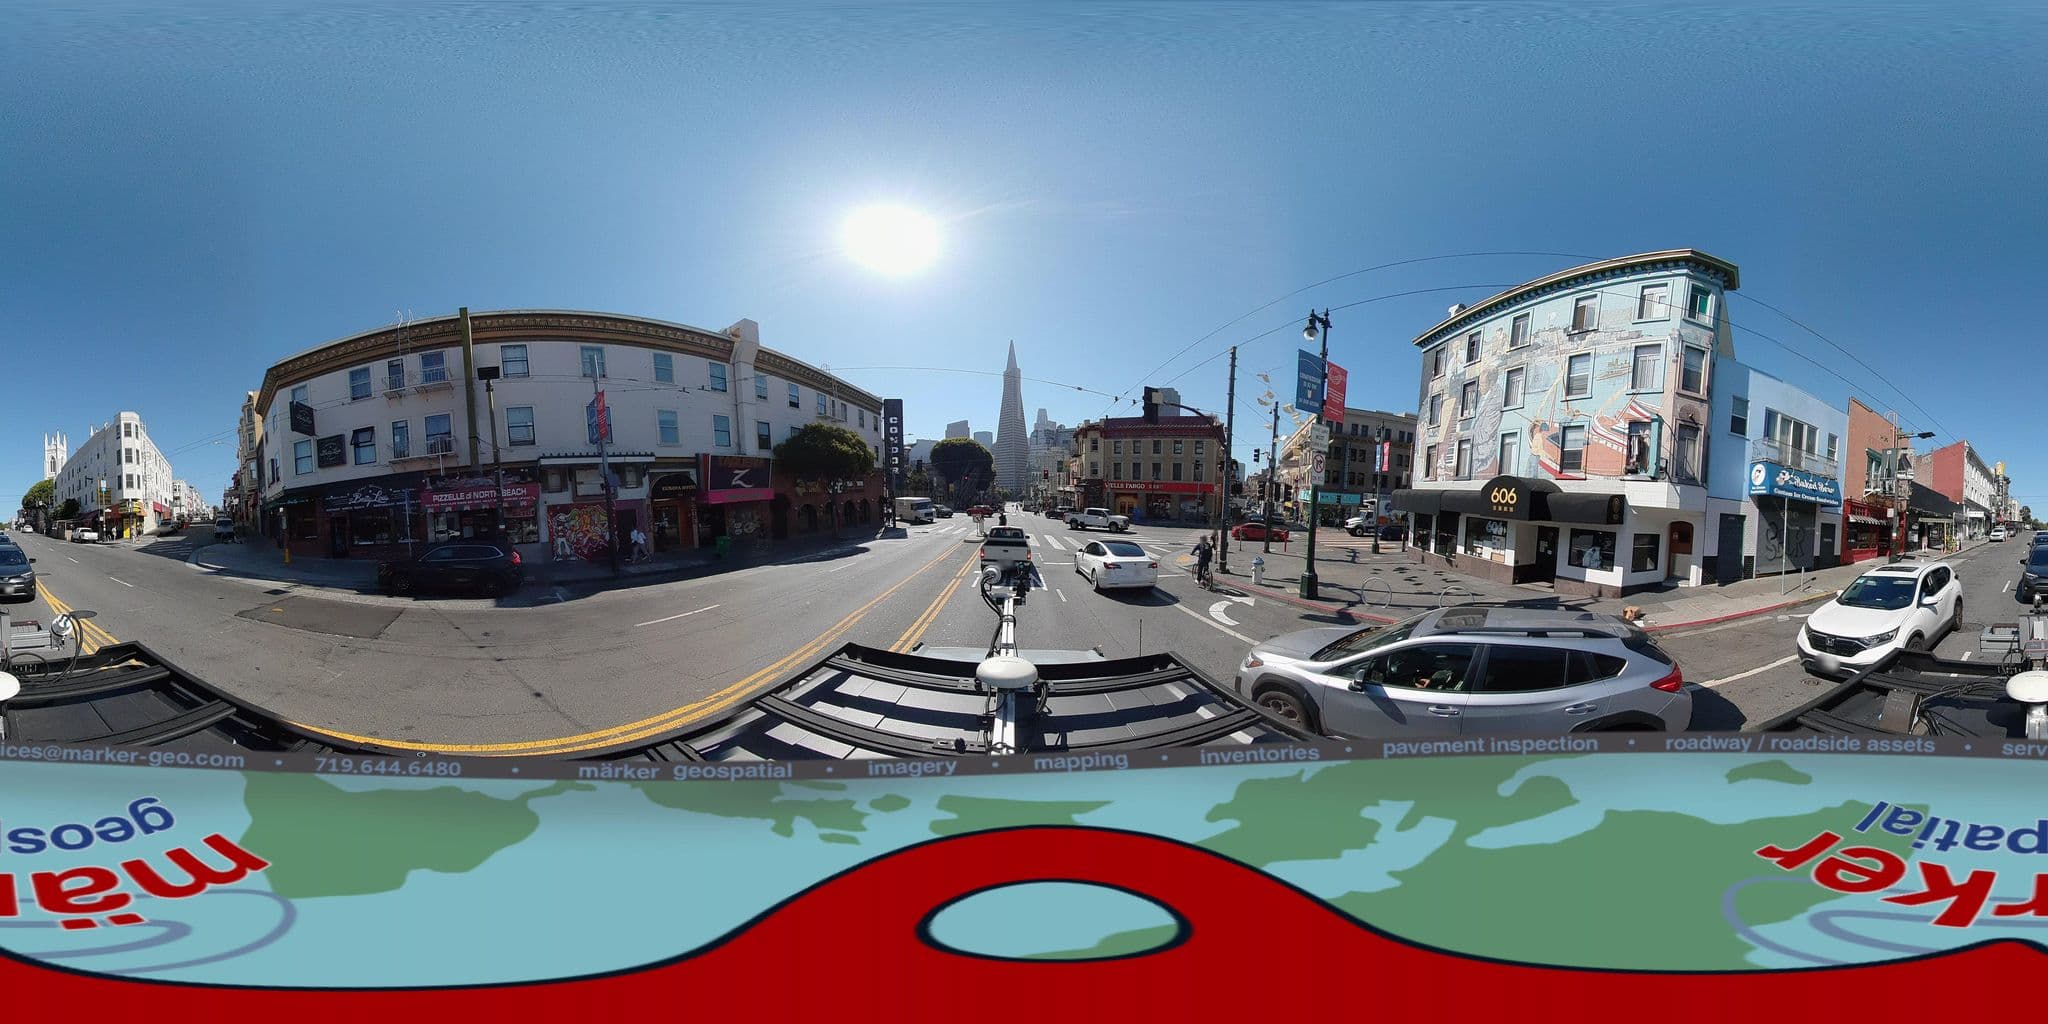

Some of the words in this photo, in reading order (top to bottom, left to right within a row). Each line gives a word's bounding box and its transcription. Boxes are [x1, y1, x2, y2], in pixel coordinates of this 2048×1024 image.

[889, 416, 900, 475] CONDOR
[731, 469, 753, 488] Z
[432, 493, 465, 502] PIZZELLE
[502, 487, 527, 497] BEACH
[1491, 487, 1517, 504] 606
